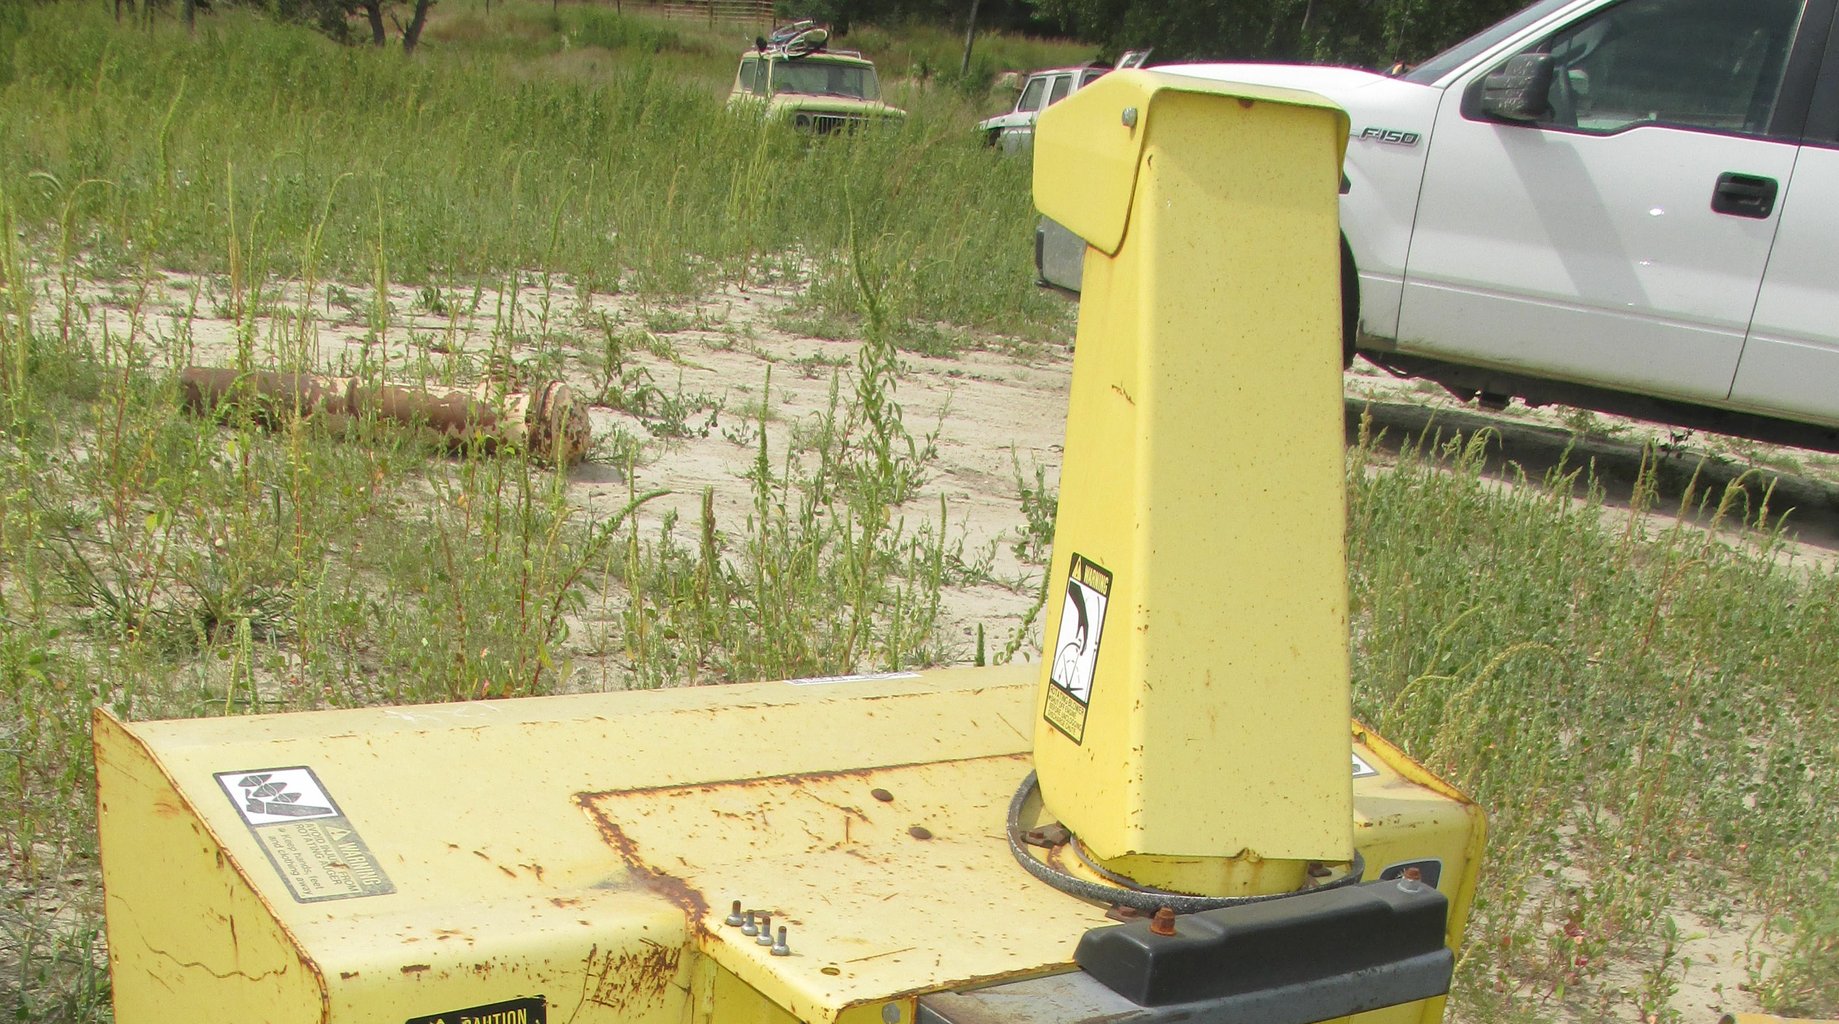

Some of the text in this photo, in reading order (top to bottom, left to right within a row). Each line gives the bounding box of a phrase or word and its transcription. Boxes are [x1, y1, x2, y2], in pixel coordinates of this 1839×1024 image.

[268, 835, 284, 849] and
[277, 849, 300, 876] clothing
[280, 833, 297, 853] Keep
[308, 875, 325, 890] feet
[295, 823, 343, 886] ROTATING AUGER
[304, 822, 325, 845] AVOID
[338, 870, 360, 893] FROM
[338, 841, 382, 887] WARNING
